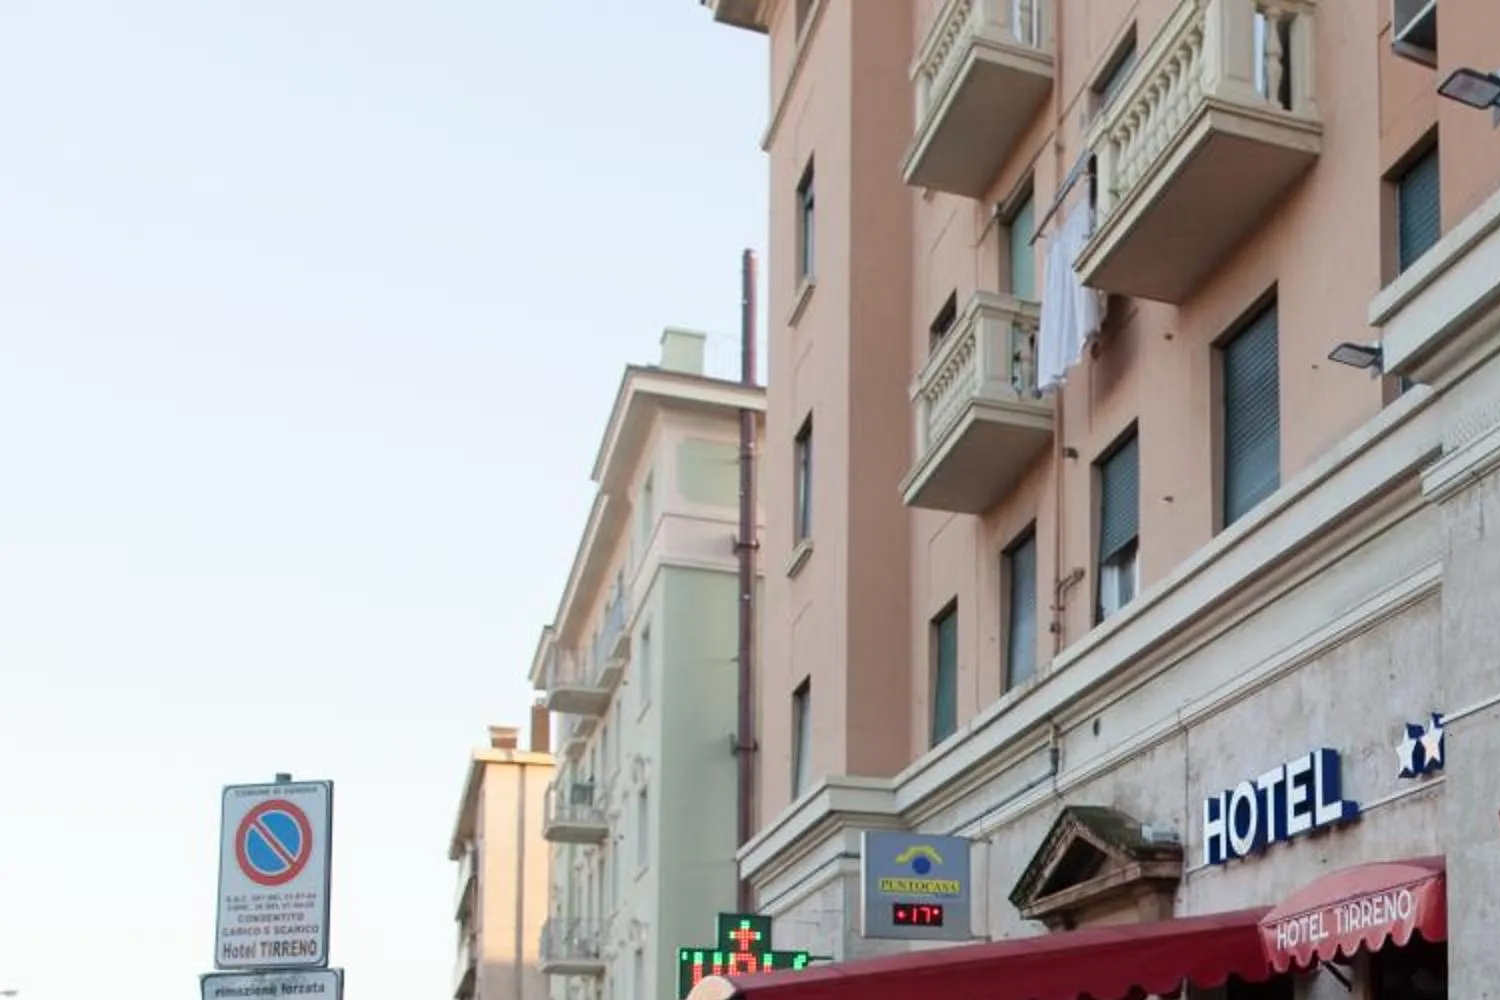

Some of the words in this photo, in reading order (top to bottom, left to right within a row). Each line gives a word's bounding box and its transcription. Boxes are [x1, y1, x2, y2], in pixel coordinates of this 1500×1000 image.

[1203, 747, 1354, 865] HOTEL
[880, 879, 958, 893] PUNTOCASA
[1276, 911, 1329, 951] HOTEL
[1333, 889, 1413, 937] TIRRENO
[222, 942, 257, 959] Hotel
[259, 939, 318, 957] TIRRENO
[214, 985, 278, 998] rimozione
[281, 982, 326, 995] forzata
